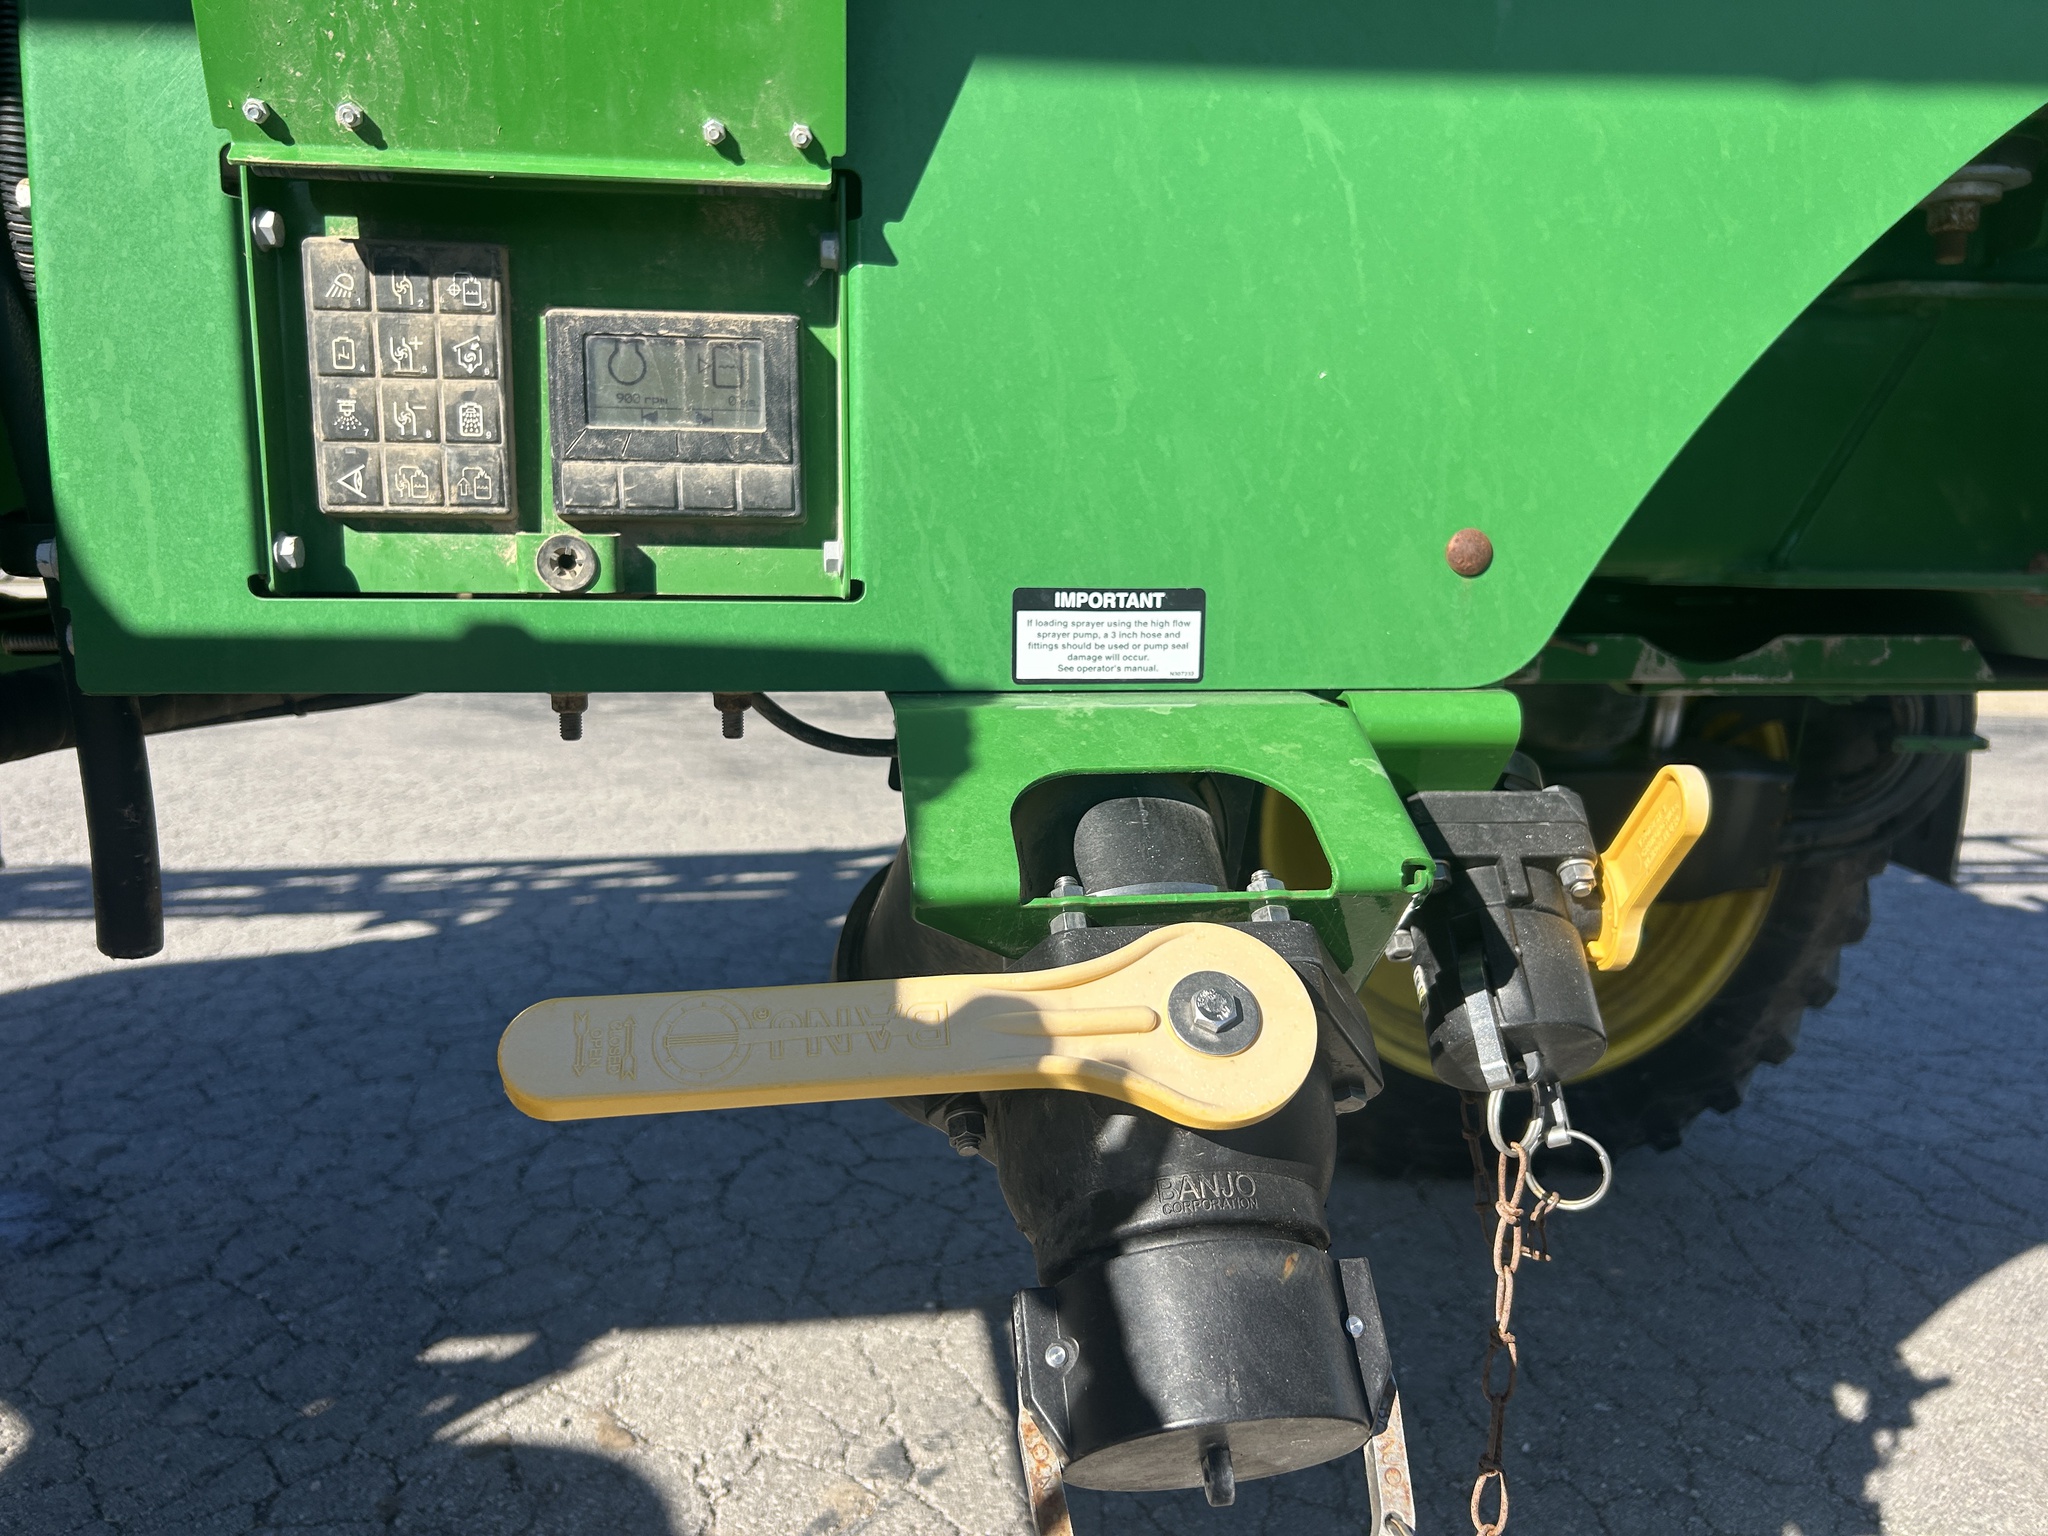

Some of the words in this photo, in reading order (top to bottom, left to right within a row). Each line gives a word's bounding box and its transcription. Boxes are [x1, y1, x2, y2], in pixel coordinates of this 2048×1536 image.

[417, 299, 424, 308] 2
[616, 393, 641, 405] 900
[1054, 591, 1166, 609] IMPORTANT
[1026, 619, 1033, 627] If
[1035, 619, 1069, 629] loading
[1070, 621, 1105, 629] sprayer
[1107, 619, 1132, 629] using
[1134, 619, 1149, 627] the
[1150, 619, 1170, 629] high
[1172, 619, 1191, 627] flow
[1036, 632, 1070, 641] sprayer
[1072, 632, 1101, 641] pump,
[1118, 631, 1138, 639] inch
[1140, 631, 1162, 639] hose
[1164, 631, 1181, 639] and
[1027, 642, 1059, 652] fittings
[1061, 642, 1092, 650] should
[1094, 642, 1105, 650] be
[1107, 642, 1129, 650] used
[1143, 643, 1169, 652] pump
[1171, 642, 1189, 650] seal
[1067, 653, 1103, 663] damage
[1105, 653, 1120, 661] will
[1057, 664, 1074, 672] See
[1076, 664, 1122, 674] operator's
[1123, 664, 1159, 672] manual.
[588, 1028, 603, 1068] OPEN
[607, 1020, 622, 1075] CLOSED
[1156, 1171, 1257, 1203] BANJO
[1162, 1196, 1259, 1216] CORPORATION
